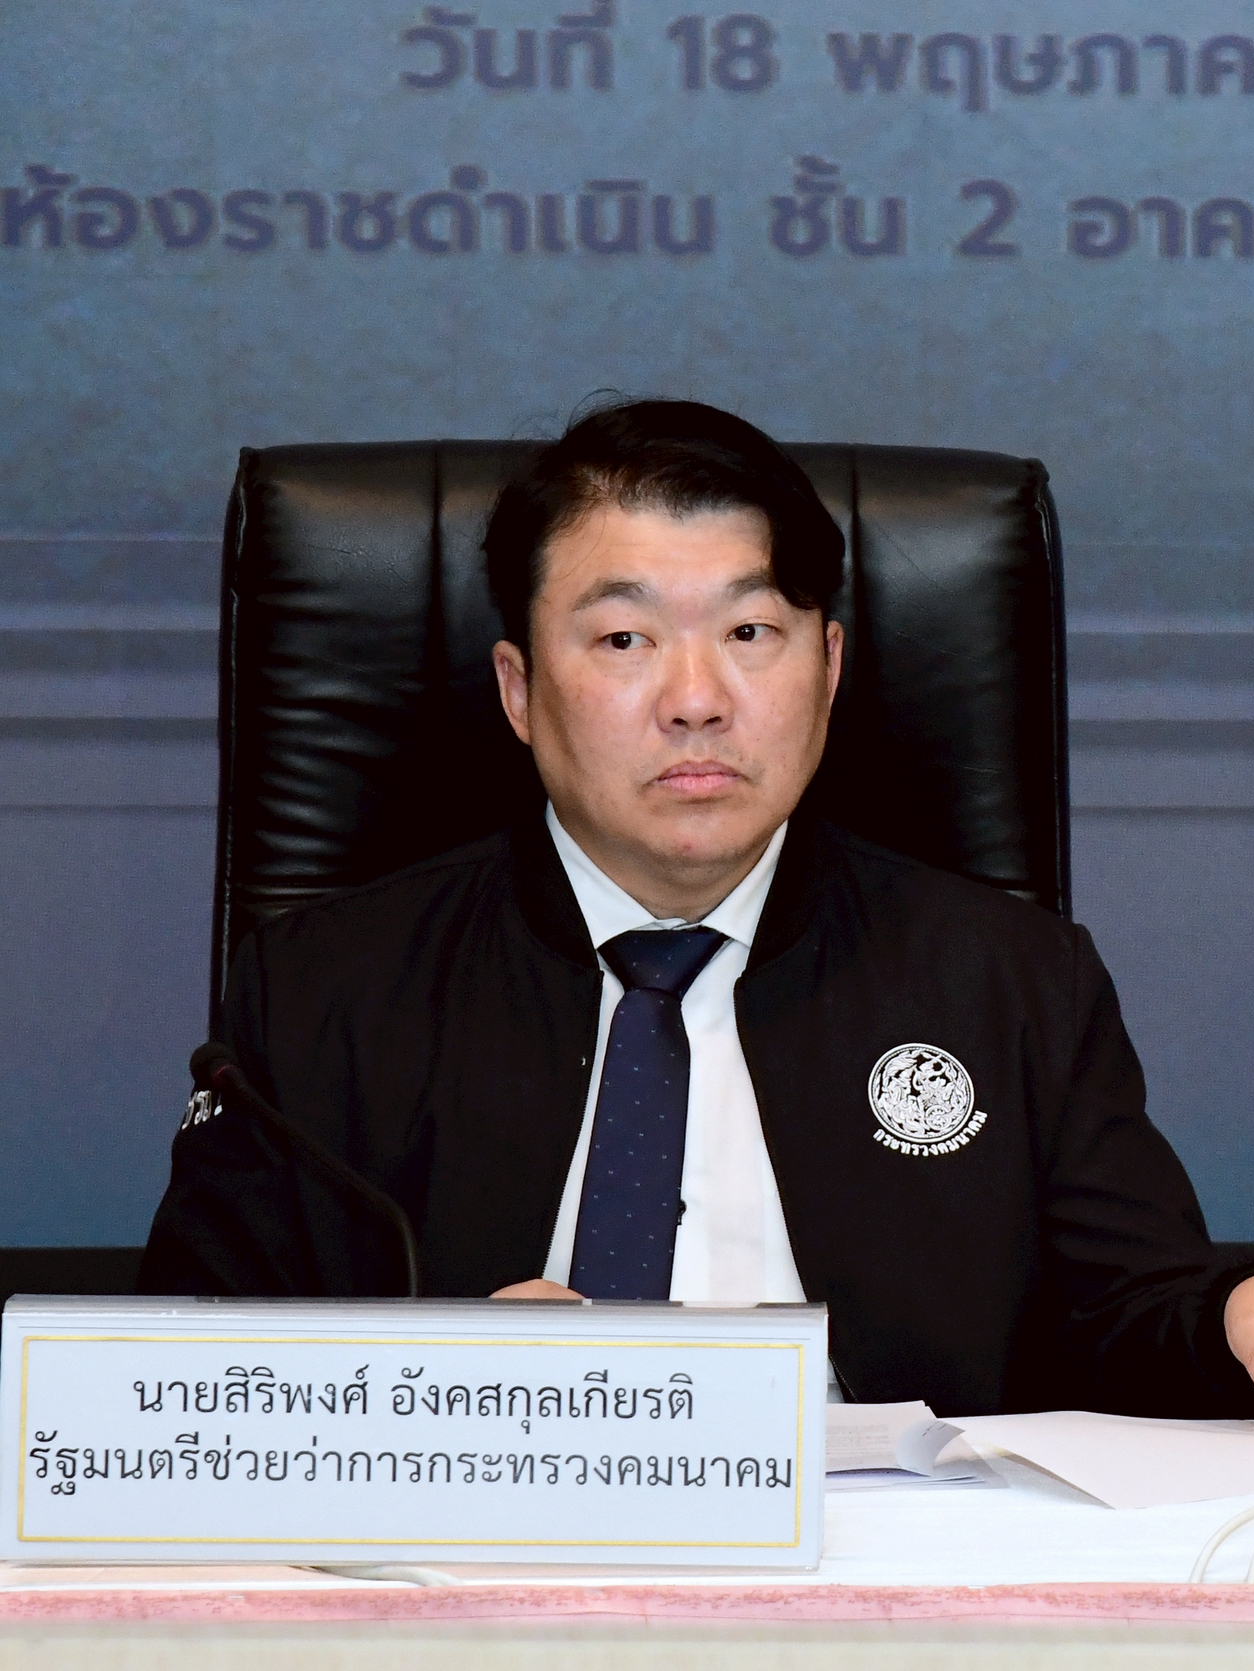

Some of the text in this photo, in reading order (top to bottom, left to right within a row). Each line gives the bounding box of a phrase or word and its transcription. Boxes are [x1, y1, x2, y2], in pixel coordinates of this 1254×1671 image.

[401, 0, 614, 91] วันที
[667, 14, 779, 92] 18
[0, 164, 714, 254] ห้องราชดำเนิน
[768, 156, 905, 258] ชั้น
[955, 180, 1020, 258] 2
[133, 1364, 694, 1435] นายสิริพงศ์ อังคสกุลเกียรติ
[29, 1431, 793, 1495] รัฐมนตรีช่วยว่าการกระทรวงคมนาคม
